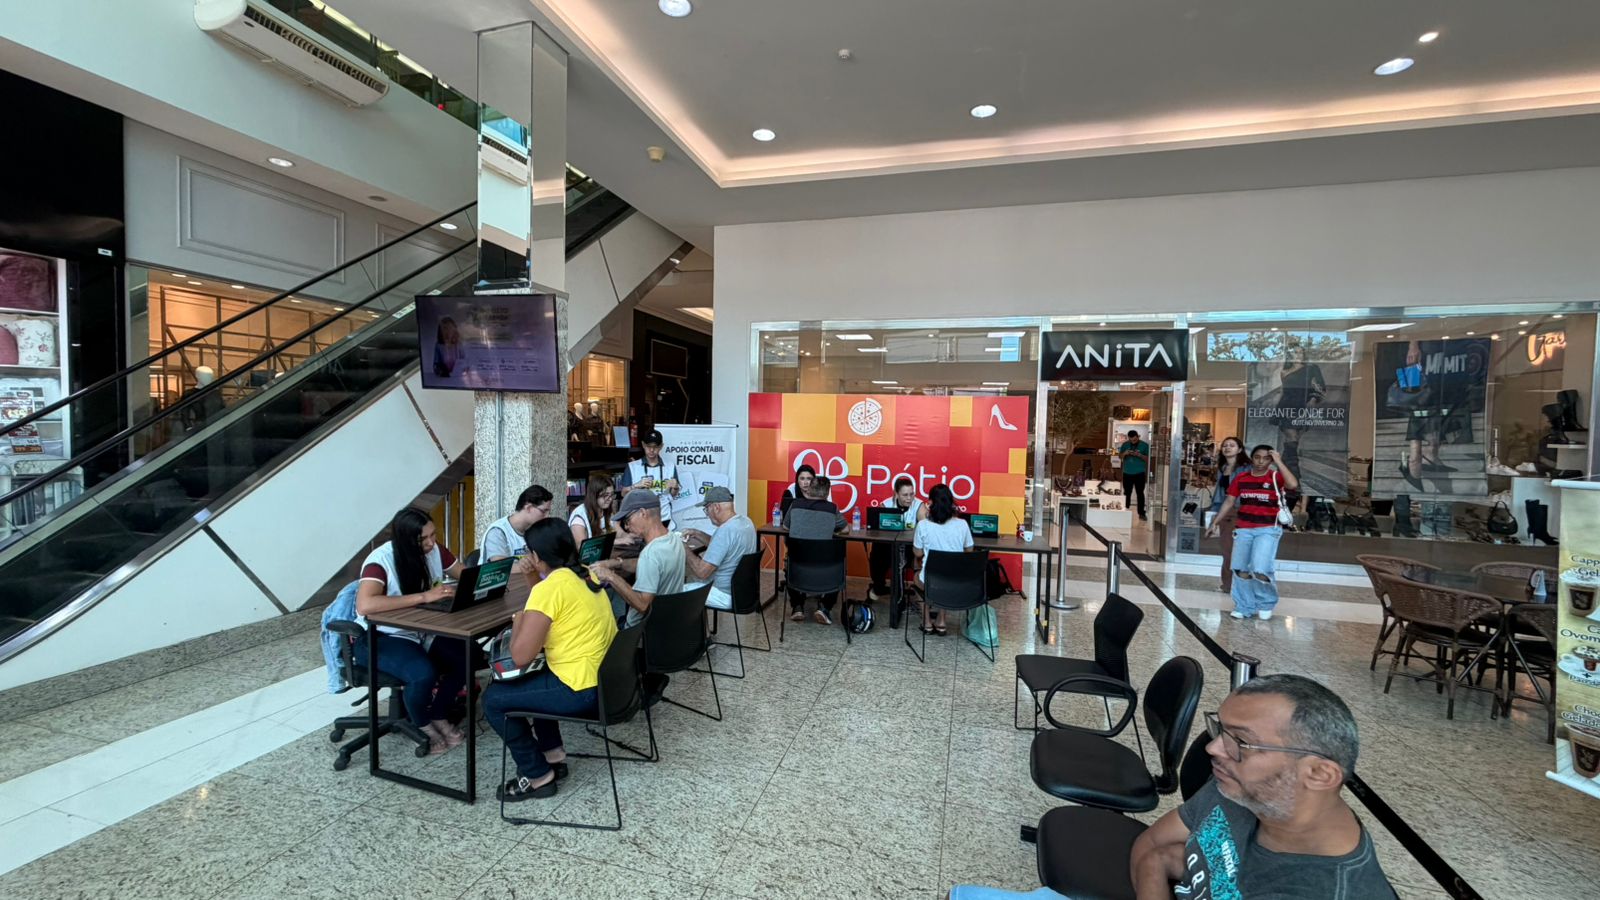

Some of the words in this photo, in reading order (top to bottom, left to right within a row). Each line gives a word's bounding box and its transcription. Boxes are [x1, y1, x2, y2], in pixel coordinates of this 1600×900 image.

[1248, 407, 1296, 418] ELEGANTE
[1298, 407, 1324, 418] ONDE
[1326, 408, 1345, 418] FOR
[665, 446, 689, 454] APOIO
[690, 444, 725, 453] CONTÁBIL
[676, 454, 715, 465] FISCAL
